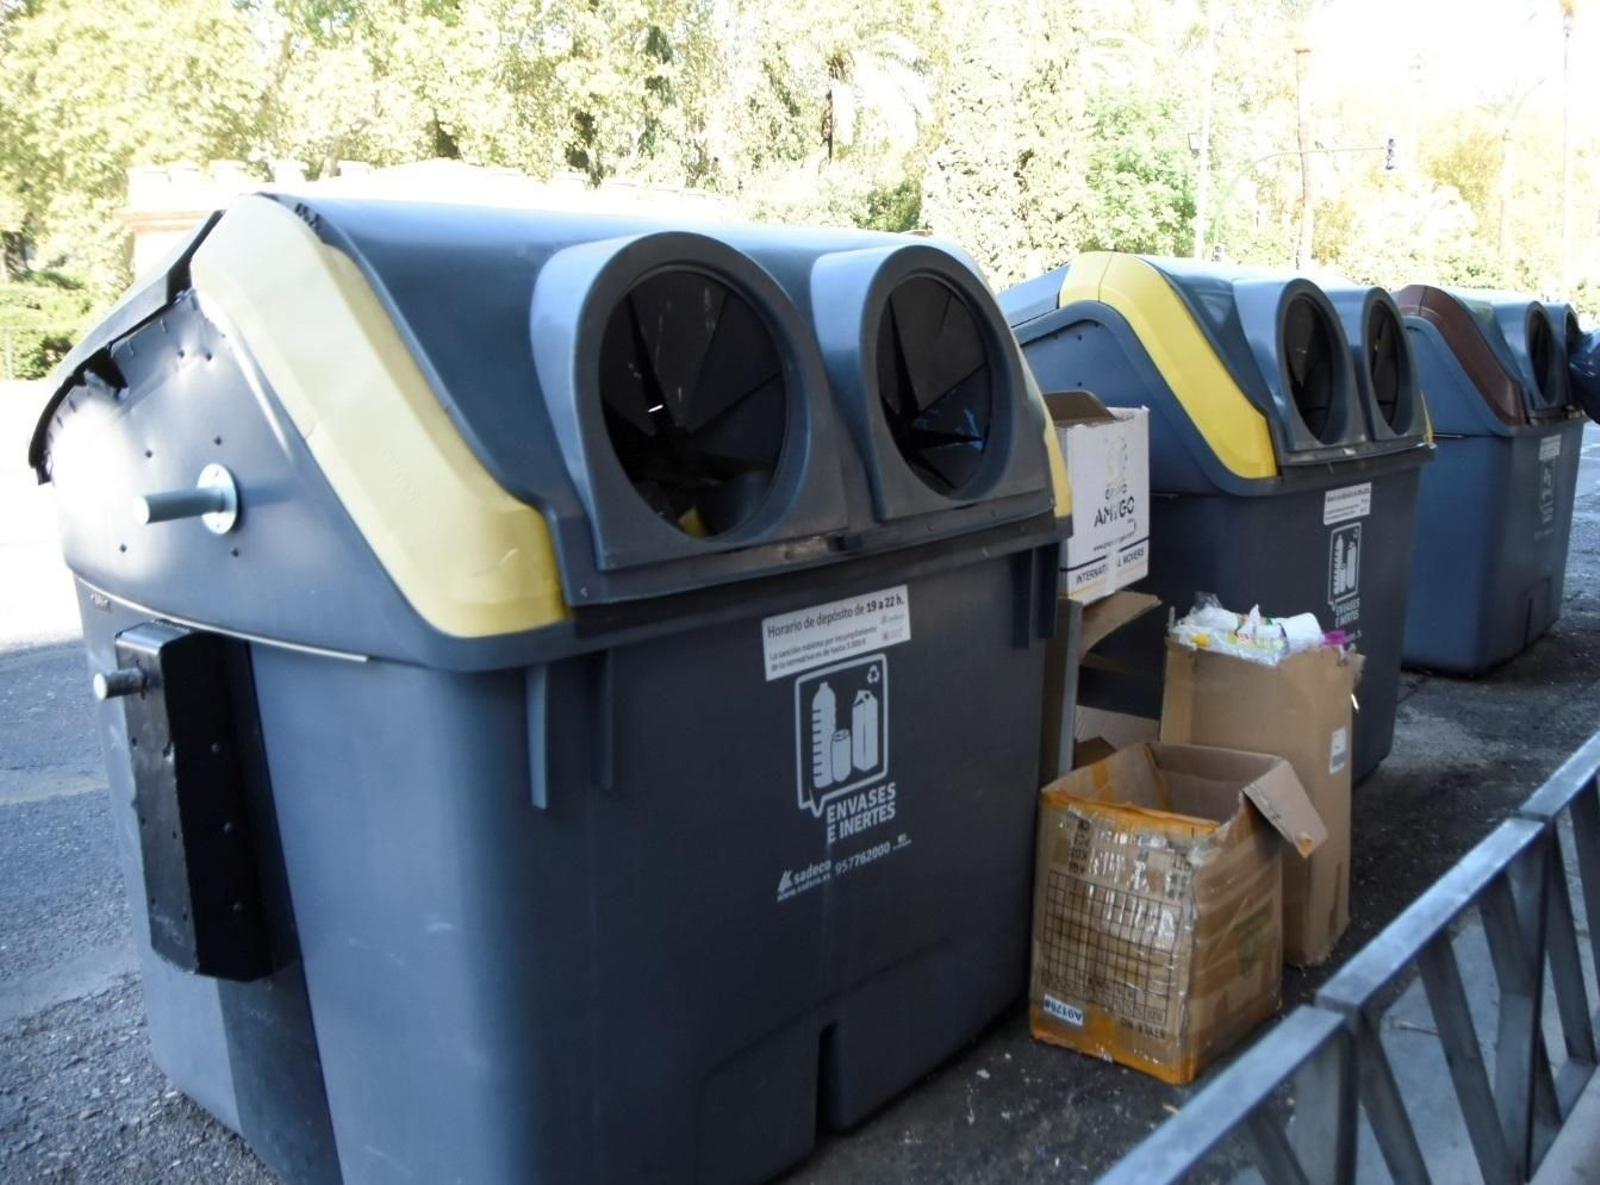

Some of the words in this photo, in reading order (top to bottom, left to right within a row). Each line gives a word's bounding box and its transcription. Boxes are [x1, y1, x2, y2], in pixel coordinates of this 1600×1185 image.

[767, 620, 803, 638] Horario
[804, 616, 815, 628] de
[816, 609, 854, 626] depósito
[855, 604, 865, 615] de
[866, 600, 876, 613] 19
[878, 600, 884, 610] a
[885, 596, 895, 608] 22
[826, 782, 897, 824] ENVASES
[827, 824, 836, 844] E
[839, 801, 897, 839] INERTES
[794, 860, 832, 884] sadeco
[835, 842, 891, 875] 957762000
